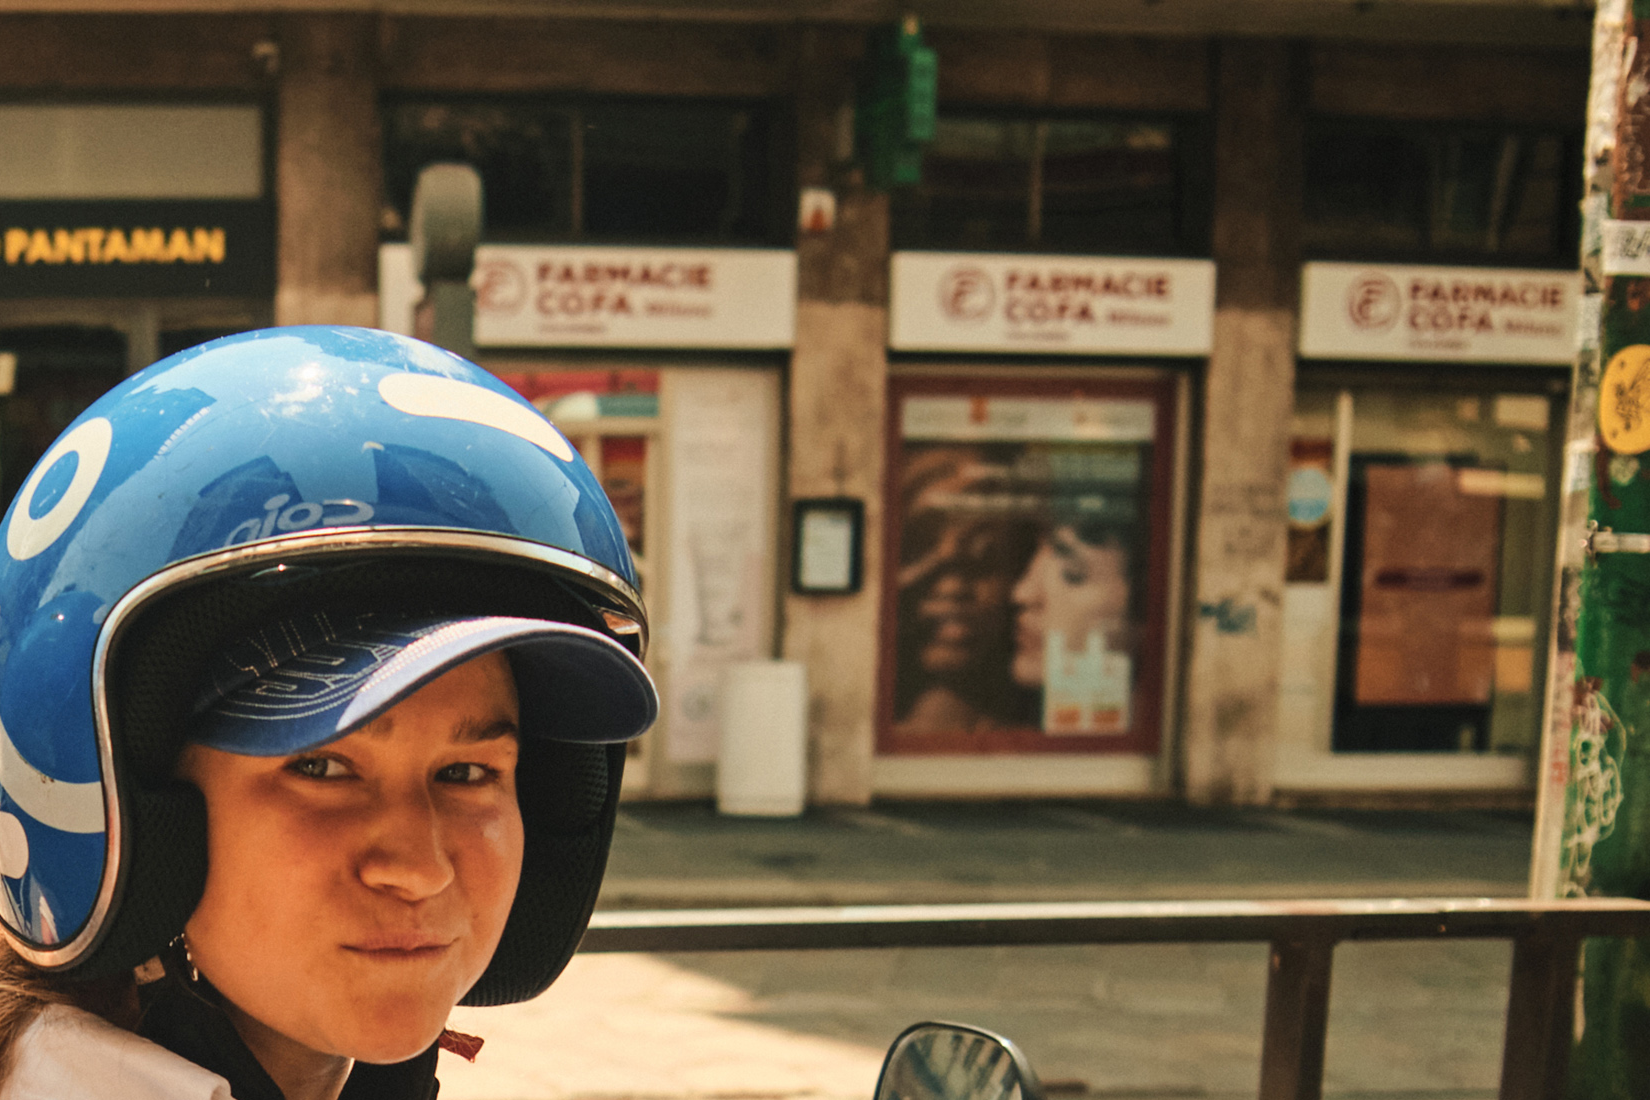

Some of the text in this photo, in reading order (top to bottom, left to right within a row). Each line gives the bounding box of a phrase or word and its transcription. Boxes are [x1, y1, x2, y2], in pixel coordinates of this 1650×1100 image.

[4, 226, 227, 266] PANTAMAN
[537, 261, 712, 290] FARMACIE
[1006, 269, 1170, 298] FARMACIE
[537, 290, 634, 317] COFA
[1410, 279, 1565, 307] FARMACIE
[1006, 298, 1096, 324] COFA
[1409, 307, 1494, 332] COFA
